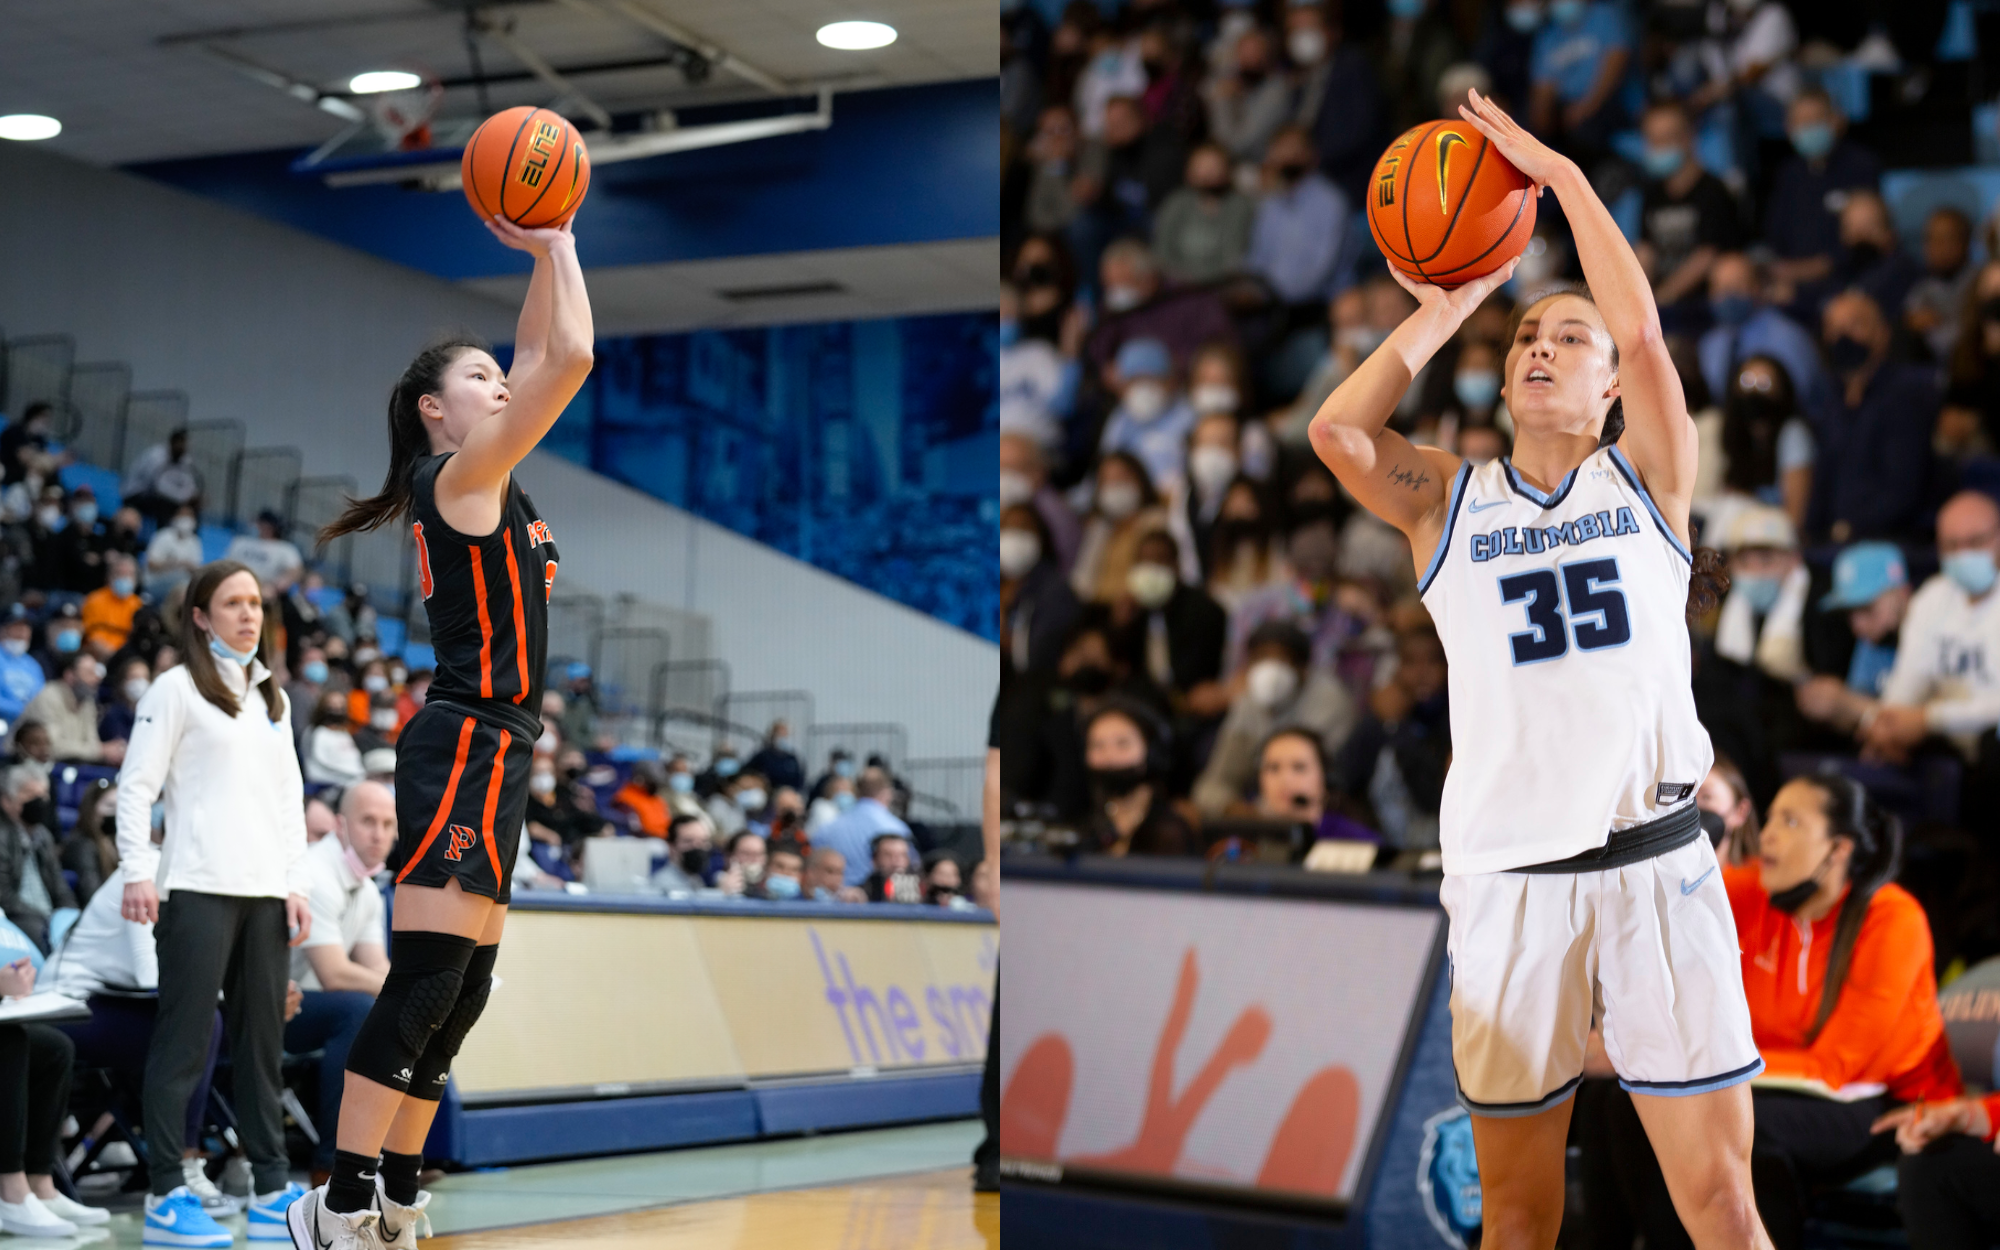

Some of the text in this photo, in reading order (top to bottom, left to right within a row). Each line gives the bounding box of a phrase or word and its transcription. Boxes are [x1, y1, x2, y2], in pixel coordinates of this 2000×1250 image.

[519, 121, 560, 189] ELITE
[1470, 506, 1640, 562] COLUMBIA
[1497, 555, 1632, 667] 35
[444, 823, 477, 862] P
[807, 925, 926, 1064] the
